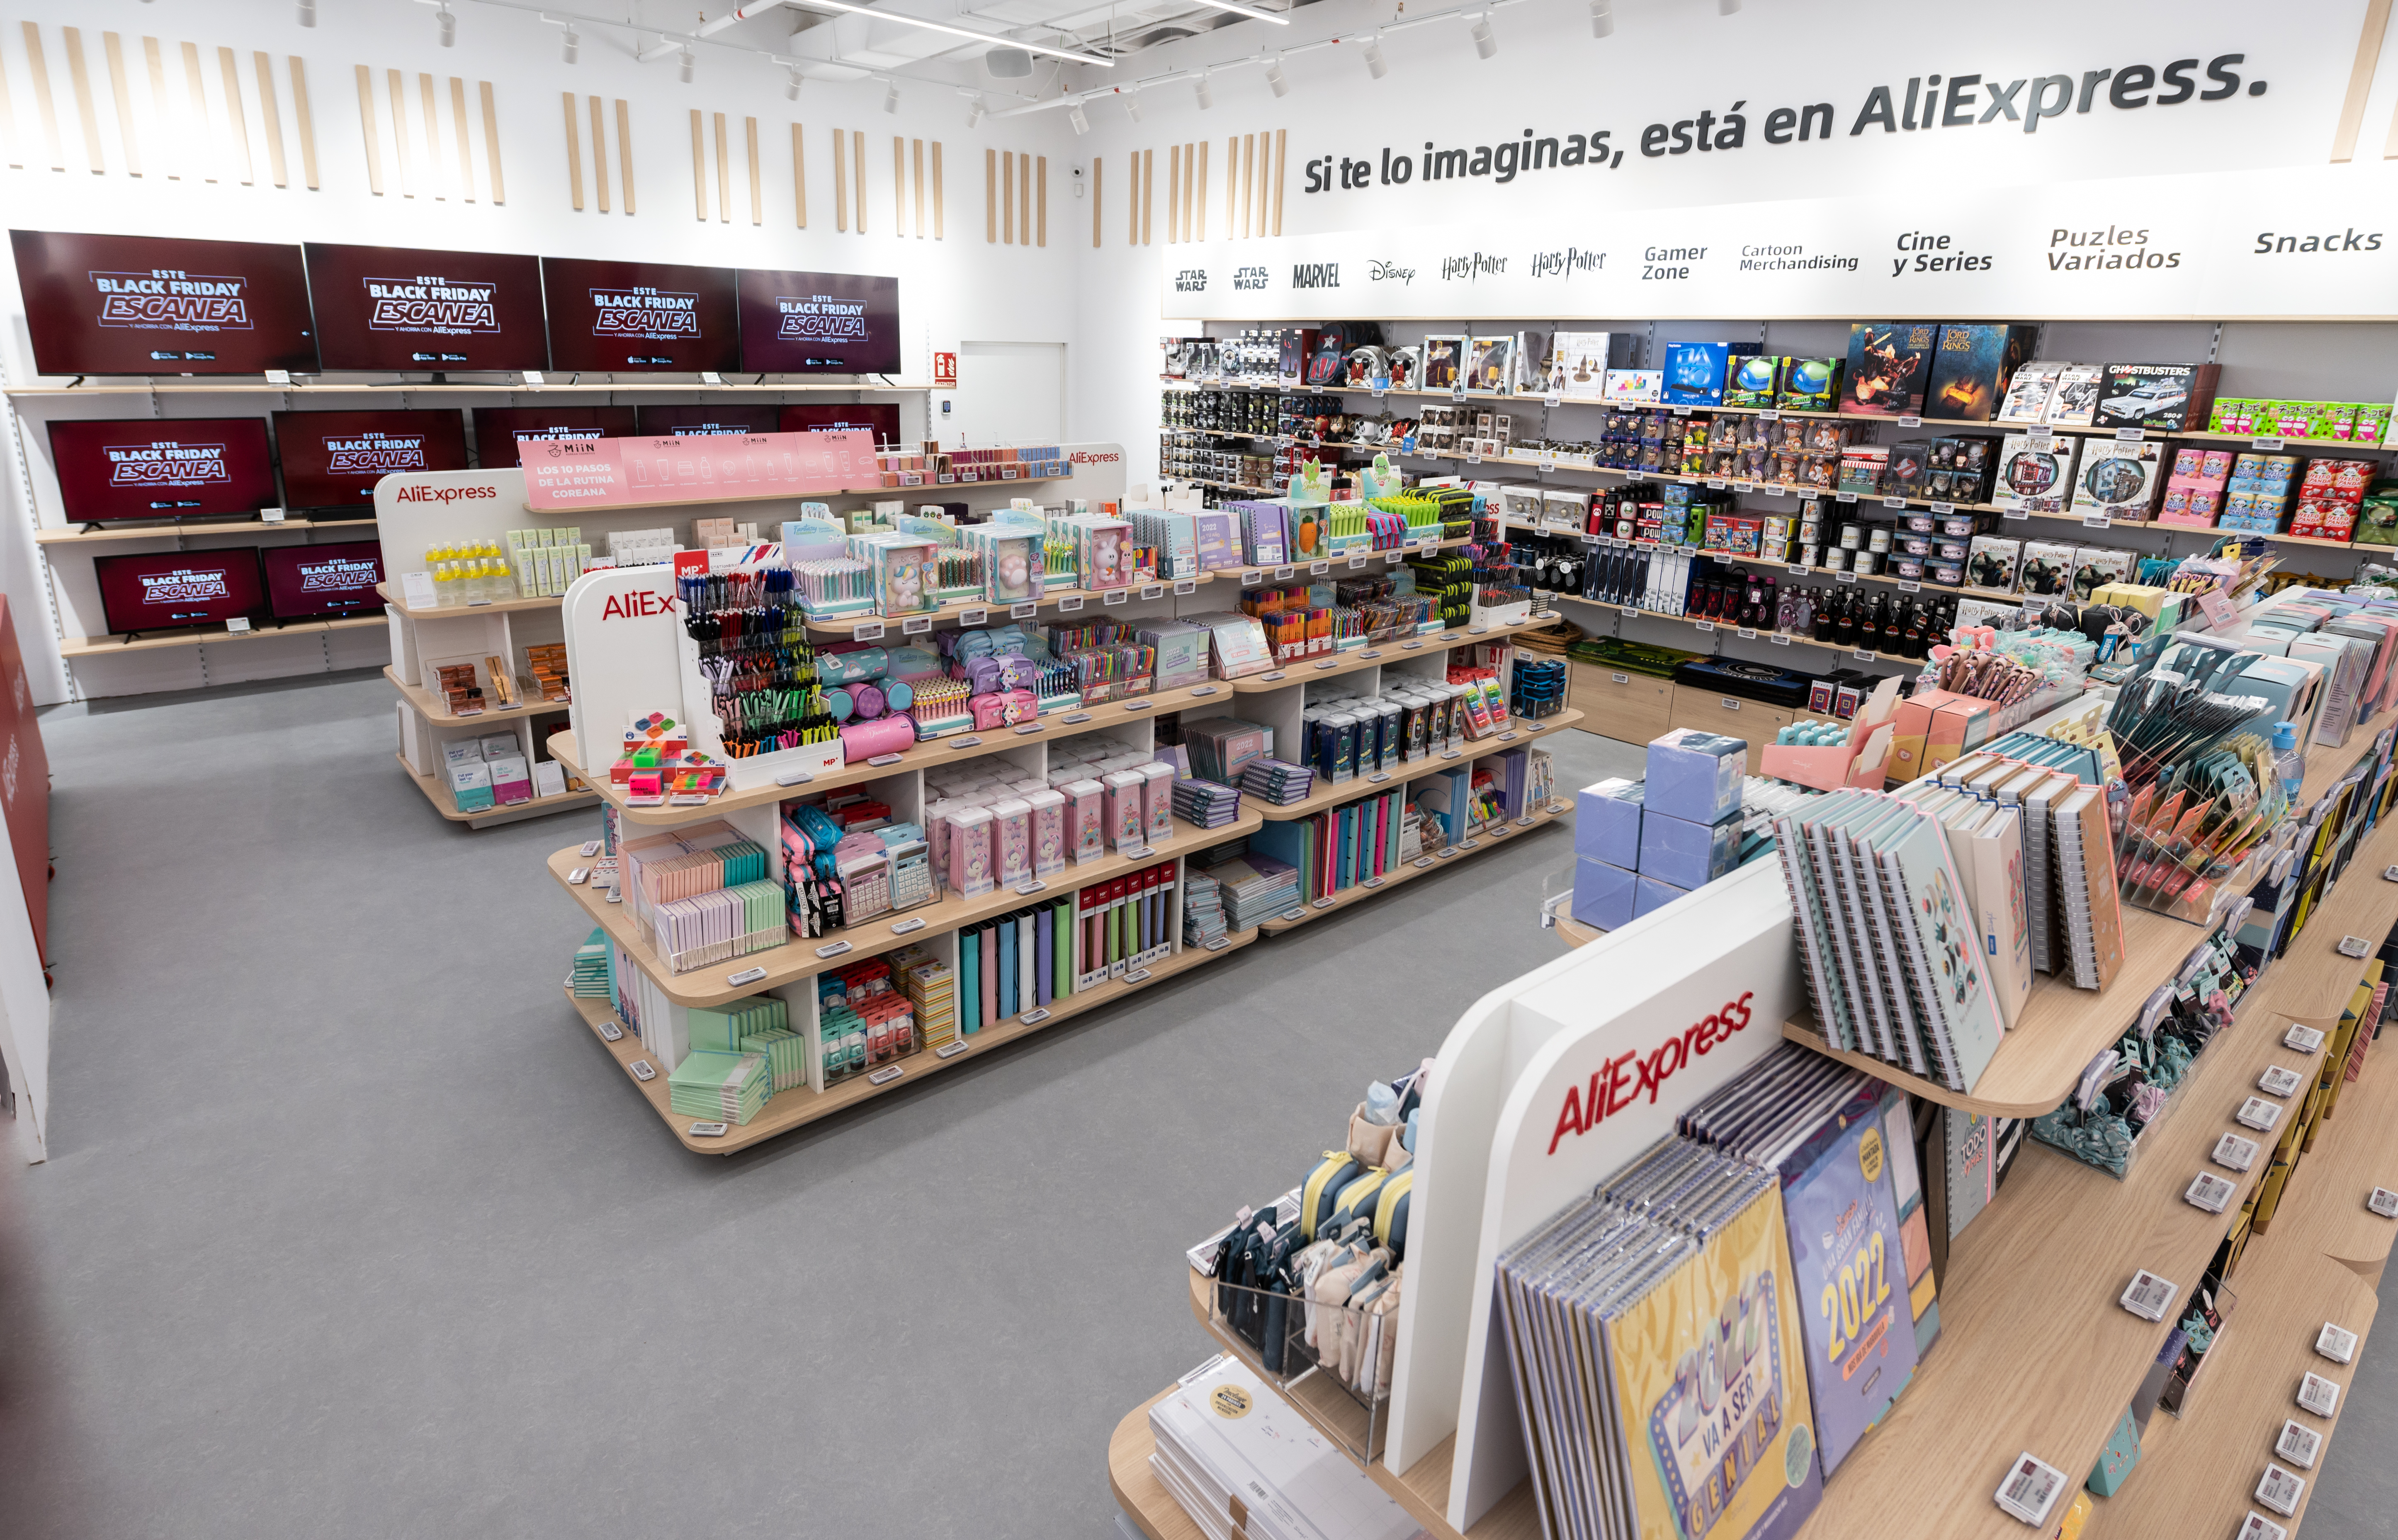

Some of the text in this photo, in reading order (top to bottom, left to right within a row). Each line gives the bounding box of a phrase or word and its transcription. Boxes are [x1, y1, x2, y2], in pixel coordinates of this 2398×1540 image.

[1305, 53, 2268, 194] Si te lo imaginas, está en AliExpress.
[1897, 231, 1951, 251] Cine
[2051, 225, 2150, 247] Puzles
[2254, 228, 2383, 253] Snacks
[1645, 246, 1708, 261] Gamer
[1742, 245, 1803, 257] Cartoon
[1531, 247, 1606, 284] Harry Potter
[1740, 255, 1859, 272] Merchandising
[1892, 251, 1993, 278] y Series
[2047, 248, 2181, 271] Variados
[152, 270, 186, 279] ESTE
[1175, 270, 1207, 280] STAR
[1234, 267, 1268, 278] STAR
[1293, 262, 1340, 289] MARVEL
[1440, 252, 1507, 286] Harry Potter
[1642, 265, 1689, 280] Zone
[97, 278, 241, 296] BLACK FRIDAY
[417, 276, 445, 285] ESTE
[1176, 280, 1207, 292] WARS
[1234, 278, 1268, 290] WARS
[369, 284, 491, 301] BLACK FRIDAY
[633, 287, 656, 295] ESTE
[594, 294, 694, 309] BLACK FRIDAY
[102, 295, 246, 322] ESCANEA
[373, 300, 494, 325] ESCANEA
[780, 302, 863, 315] BLACK FRIDAY
[596, 309, 696, 332] ESCANEA
[781, 315, 864, 335] ESCANEA
[433, 326, 471, 336] AliExpress
[645, 333, 677, 341] AliExpress
[1947, 330, 1969, 341] LORD
[1942, 341, 1970, 350] RINGS
[327, 439, 420, 451] BLACK FRIDAY
[564, 444, 594, 452] MiiN
[2011, 439, 2050, 453] Harry Potter
[2092, 445, 2135, 458] Harry Potter
[109, 448, 221, 462] BLACK FRIDAY
[330, 450, 424, 469] ESCANEA
[1070, 451, 1118, 465] AliExpress
[114, 460, 226, 481] ESCANEA
[576, 464, 611, 472] PASOS
[538, 478, 554, 486] DE
[573, 476, 614, 484] RUTINA
[1374, 472, 1391, 483] Squishy
[552, 488, 606, 498] COREANA
[1302, 481, 1320, 493] Squishy
[397, 484, 496, 504] AliExpress
[1007, 515, 1024, 524] Fantasy
[1646, 509, 1663, 519] POW
[794, 524, 817, 534] Fantasy
[913, 525, 932, 534] Fantasy
[1644, 527, 1661, 538] POW
[1345, 539, 1362, 550] Squishy
[2000, 544, 2012, 553] Potter
[2042, 551, 2068, 560] Harry Potter
[2108, 558, 2122, 566] Potter
[301, 562, 374, 575] BLACK FRIDAY
[142, 573, 222, 586] BLACK FRIDAY
[304, 570, 377, 589] ESCANEA
[146, 581, 226, 600] ESCANEA
[603, 589, 675, 620] AliEx
[1166, 647, 1181, 657] 2022
[1167, 657, 1188, 668] ESPECTACULAR
[870, 726, 890, 738] Diamond
[1237, 739, 1253, 751] 2022
[966, 886, 981, 894] PENCIL
[798, 887, 808, 912] SAMPACK
[1548, 992, 1754, 1155] AliExpress
[1961, 1124, 1986, 1164] TODO
[1836, 1227, 1852, 1261] GRAN
[1852, 1194, 1873, 1229] FAMILIA
[1821, 1231, 1890, 1362] 2022
[1224, 1388, 1246, 1402] Incluye
[1703, 1373, 1754, 1459] VA A SER
[1691, 1392, 1780, 1536] GENIAL
